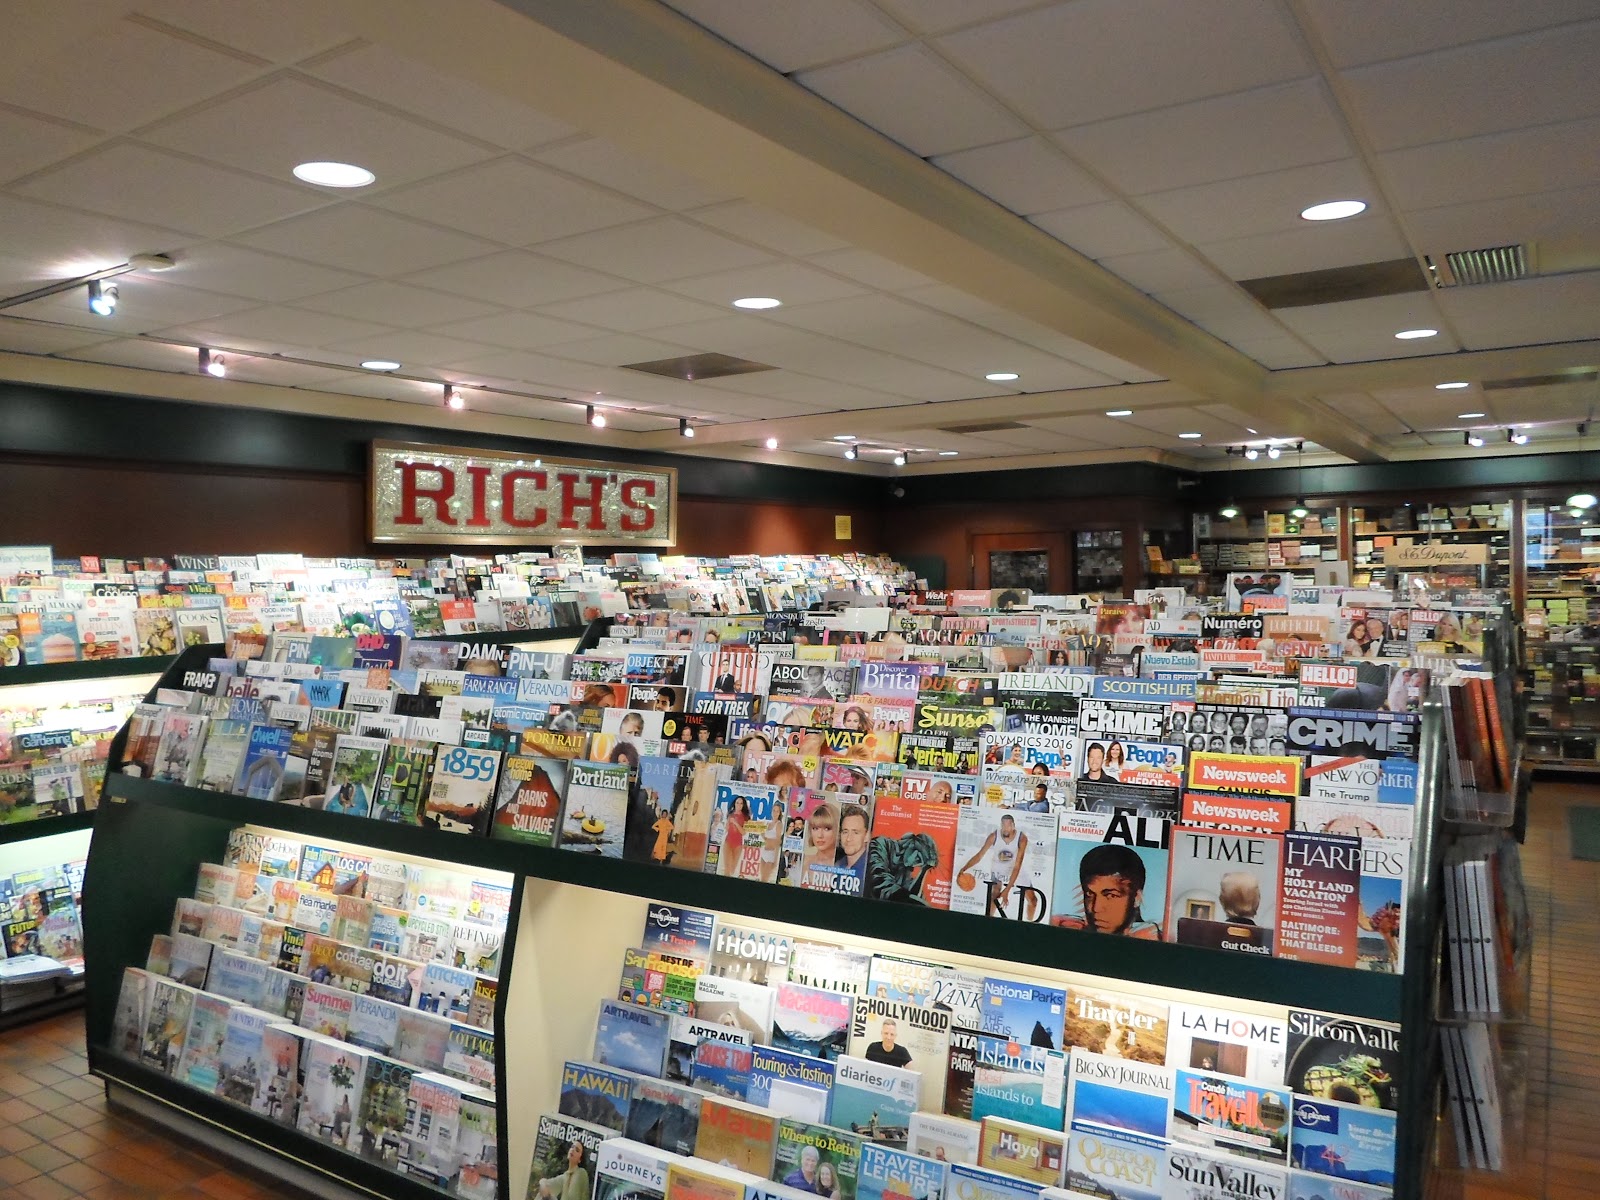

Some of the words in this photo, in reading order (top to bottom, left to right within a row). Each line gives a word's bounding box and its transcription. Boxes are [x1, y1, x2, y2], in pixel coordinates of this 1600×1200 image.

[394, 460, 655, 531] RICH'S
[180, 558, 215, 569] WINE
[1147, 622, 1161, 631] AD
[1204, 617, 1262, 629] Numéro
[357, 634, 384, 650] DHD
[1117, 636, 1144, 644] marie
[628, 656, 668, 668] OBJEKT
[1144, 655, 1170, 666] Nuevo
[1172, 655, 1196, 665] Estilo
[879, 664, 908, 674] Discover
[1302, 666, 1356, 685] HELLO!
[225, 676, 259, 698] belle
[424, 672, 459, 693] Living
[489, 681, 517, 694] RANCH
[522, 680, 568, 697] VERANDA
[919, 677, 979, 691] DUTCH
[1003, 675, 1084, 690] IRELAND
[1102, 681, 1169, 695] SCOTTISH
[1170, 682, 1193, 696] LIFE
[572, 687, 583, 700] Us
[631, 688, 658, 703] People
[696, 700, 723, 715] STAR
[724, 700, 750, 716] TREK
[1082, 701, 1107, 709] REAL
[1299, 696, 1326, 707] KATE
[494, 706, 519, 719] atomic
[521, 711, 544, 721] ranch
[549, 705, 560, 714] LIFE
[872, 707, 910, 723] People
[918, 706, 995, 728] Sunset
[684, 715, 705, 724] TIME
[1024, 714, 1040, 722] THE
[1081, 709, 1163, 735] CRIME
[22, 736, 71, 748] Gardening
[252, 727, 281, 745] dwell
[466, 732, 488, 741] ARCADE
[526, 732, 584, 748] PORTRAIT
[986, 734, 1041, 748] OLYMPICS
[1045, 737, 1073, 749] 2016
[1288, 718, 1414, 751] CRIME
[312, 748, 333, 759] Rooms
[669, 742, 687, 753] LIFE
[1388, 744, 1412, 752] SCENE
[310, 757, 320, 766] We
[441, 748, 495, 782] 1859
[507, 758, 535, 769] oregon
[1359, 762, 1374, 770] THE
[308, 766, 322, 776] Love
[509, 770, 532, 782] home
[572, 766, 628, 791] Portland
[1137, 771, 1163, 779] AMERICAN
[1203, 765, 1287, 784] Newsweek
[905, 779, 928, 792] TV
[985, 771, 1012, 782] Where
[1013, 775, 1029, 784] Are
[1030, 776, 1051, 789] They
[1355, 770, 1413, 789] YORKER
[517, 789, 548, 808] BARNS
[905, 791, 926, 800] GUIDE
[1318, 789, 1337, 799] The
[1339, 791, 1370, 802] Trump
[506, 803, 519, 814] AND
[880, 810, 912, 819] Economist
[1192, 800, 1280, 822] Newsweek
[512, 814, 554, 835] SALVAGE
[1061, 825, 1105, 836] MUHAMMAD
[1102, 814, 1170, 849] ALI
[742, 848, 760, 861] 100
[1186, 834, 1265, 865] TIME
[338, 858, 353, 870] LOG
[739, 861, 760, 877] LBS!
[972, 869, 989, 879] The
[1284, 867, 1304, 878] MY
[801, 871, 810, 885] A
[812, 871, 838, 890] RING
[839, 875, 861, 893] FOR
[1284, 878, 1316, 890] HOLY
[1319, 882, 1354, 894] LAND
[1284, 887, 1346, 903] VACATION
[1281, 920, 1340, 936] BALTIMORE:
[1281, 929, 1297, 940] THE
[1299, 932, 1323, 942] CITY
[454, 926, 499, 946] REFINED
[725, 936, 788, 964] HOME
[1222, 940, 1238, 951] Gut
[1240, 942, 1270, 955] Check
[1280, 939, 1305, 949] THAT
[1307, 941, 1344, 954] BLEEDS
[1279, 952, 1297, 960] PLUS
[374, 959, 396, 979] do
[425, 963, 474, 988] KITCHEN
[698, 986, 724, 996] MAGAZINE
[699, 981, 718, 989] MALIBU
[354, 995, 396, 1022] VERANDA
[603, 1005, 652, 1026] ARTRAVEL
[869, 999, 948, 1029] HOLLYWOOD
[1075, 997, 1159, 1030] Traveler
[854, 997, 869, 1038] WEST
[983, 1014, 1003, 1024] THE
[688, 1025, 746, 1045] ARTRAVEL
[982, 1023, 999, 1034] AIR
[1002, 1025, 1012, 1034] IS
[1182, 1011, 1208, 1031] LA
[1214, 1018, 1281, 1044] HOME
[1289, 1012, 1355, 1044] Silicon
[979, 1040, 1045, 1075] Islands
[841, 1065, 883, 1087] diaries
[883, 1077, 896, 1092] of
[1075, 1058, 1094, 1075] BIG
[1096, 1062, 1118, 1079] SKY
[1118, 1068, 1171, 1091] JOURNAL
[976, 1085, 1020, 1102] Islands
[1022, 1094, 1034, 1107] to
[1227, 1085, 1246, 1098] Nast
[539, 1117, 566, 1138] Santa
[778, 1126, 813, 1147] Where
[815, 1135, 827, 1148] to
[828, 1138, 861, 1157] Retire
[604, 1160, 662, 1186] JOURNEYS
